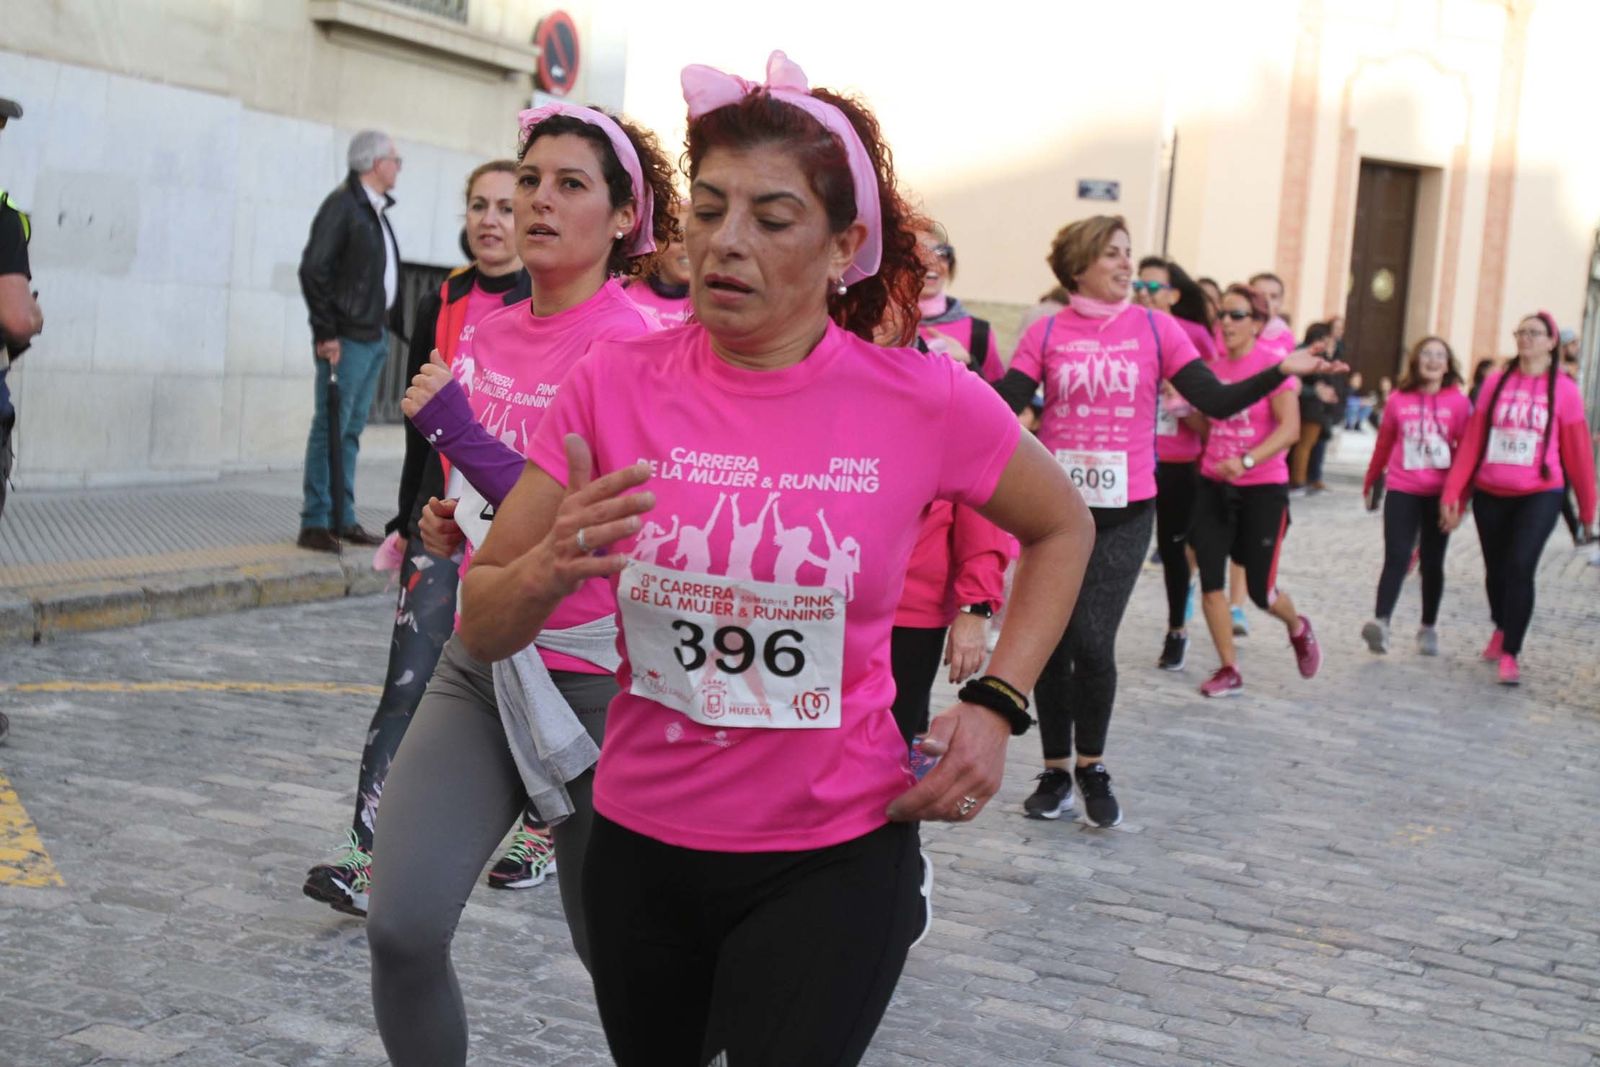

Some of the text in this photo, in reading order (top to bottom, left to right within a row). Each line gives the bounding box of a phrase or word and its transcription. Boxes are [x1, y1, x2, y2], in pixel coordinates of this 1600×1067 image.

[535, 383, 560, 396] PINK
[670, 447, 880, 475] CARRERA PINK
[661, 461, 682, 481] LA
[687, 468, 758, 488] MUJER
[761, 476, 773, 490] &
[779, 473, 880, 493] RUNNING
[1070, 467, 1116, 490] 609
[630, 586, 835, 622] DE LA MUJER & RUNNING
[659, 578, 735, 601] CARRERA
[793, 593, 835, 608] PINK
[671, 619, 805, 678] 396
[728, 705, 772, 717] HUELVA
